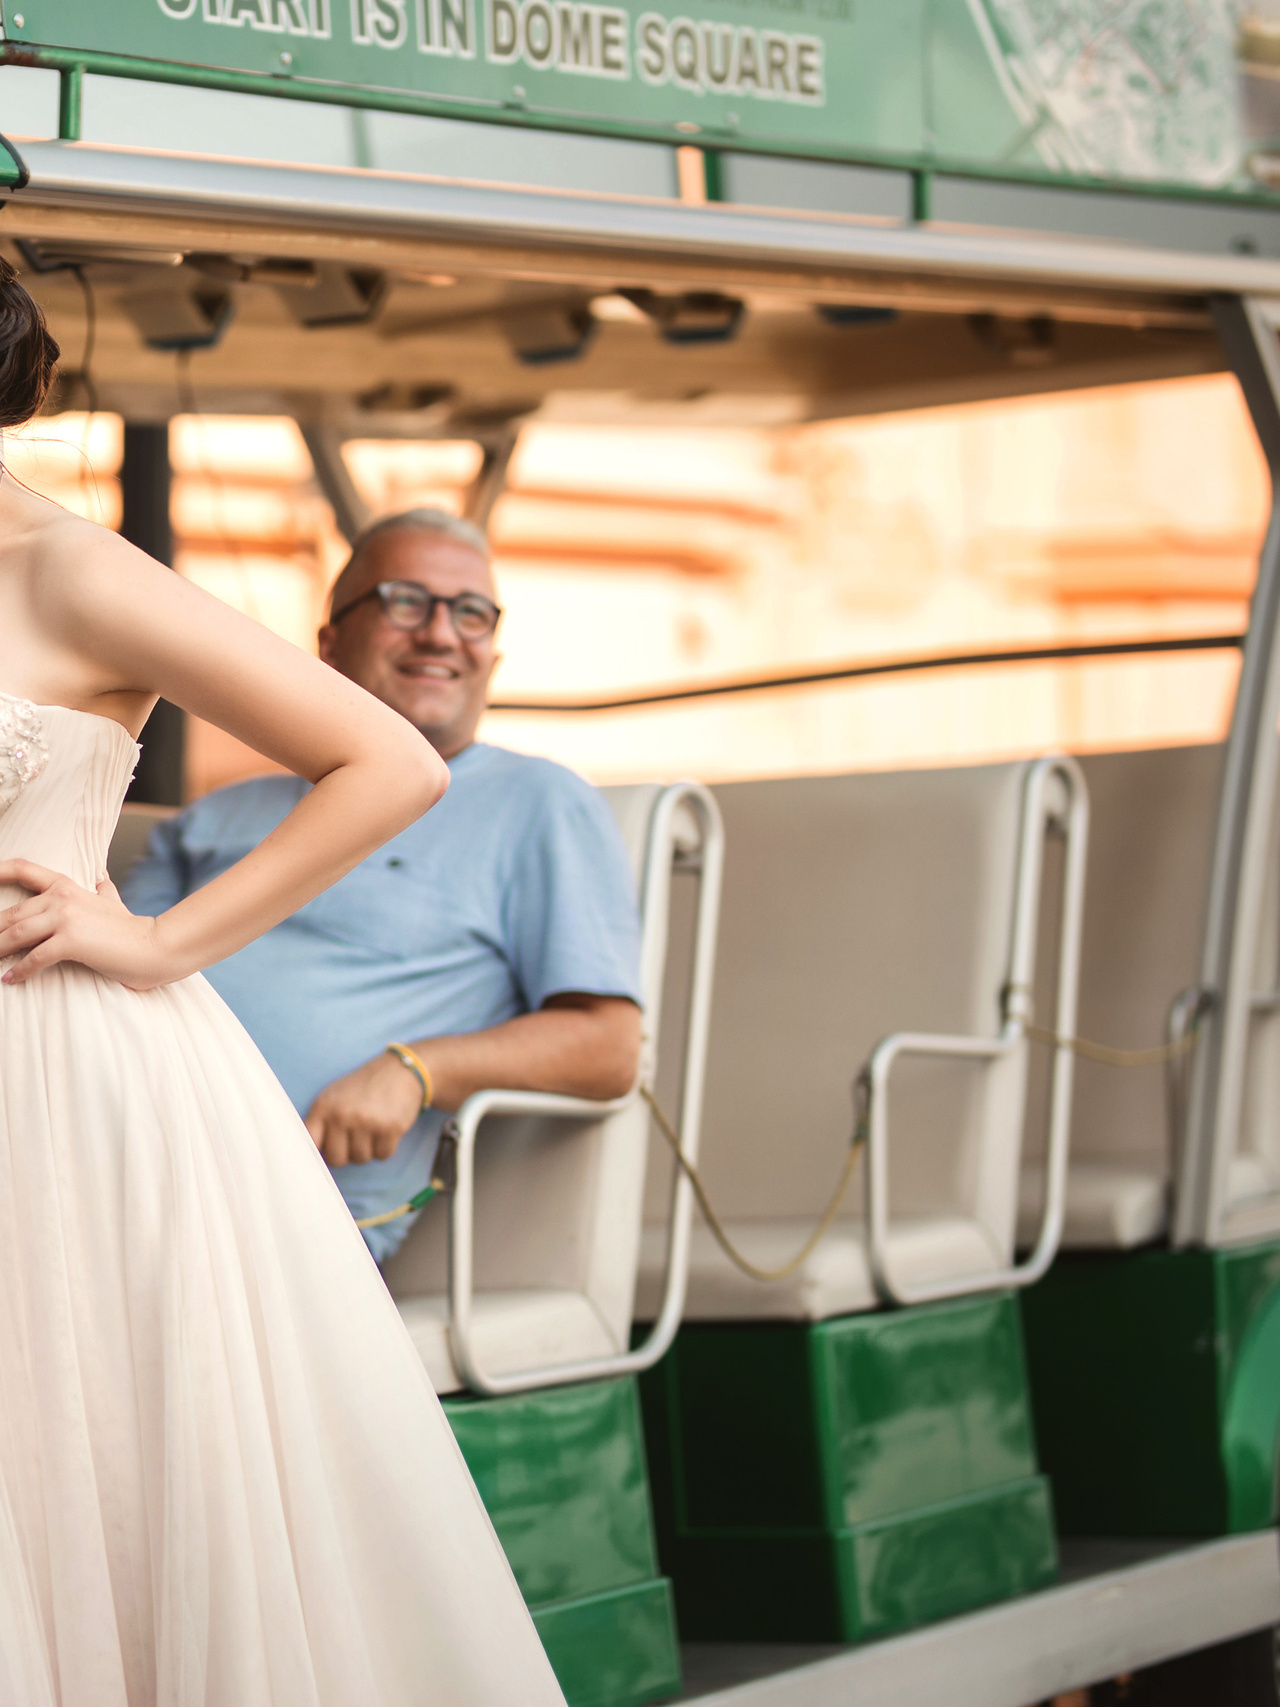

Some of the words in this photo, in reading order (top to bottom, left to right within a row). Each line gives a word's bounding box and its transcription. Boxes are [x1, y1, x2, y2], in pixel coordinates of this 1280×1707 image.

[351, 0, 407, 49] IS
[416, 0, 476, 59] IN
[484, 0, 631, 81] DOME
[635, 12, 826, 107] SQUARE
